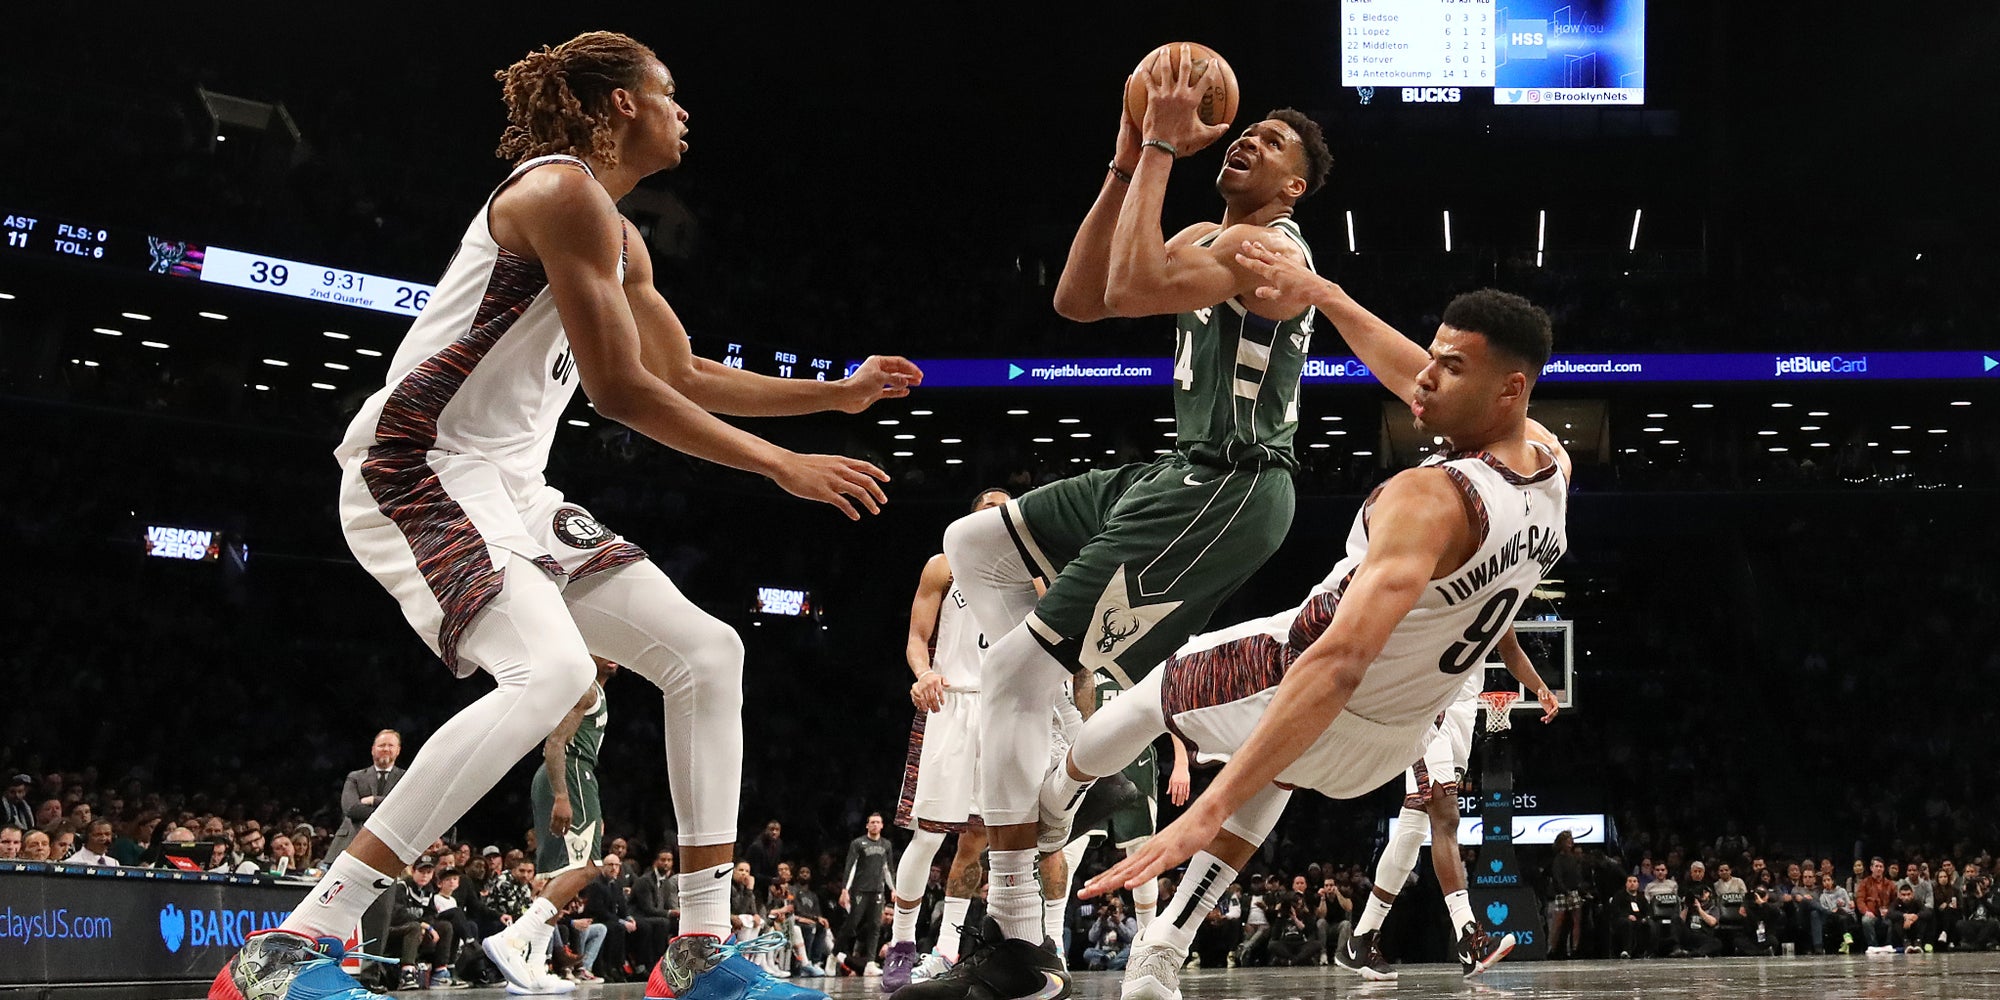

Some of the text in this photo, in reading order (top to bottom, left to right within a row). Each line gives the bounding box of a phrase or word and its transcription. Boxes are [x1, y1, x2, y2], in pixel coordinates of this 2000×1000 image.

[1349, 14, 1487, 22] 6 Bledsoe 0 3 3
[1347, 28, 1487, 37] 11 Lopez 6 1 2
[1556, 25, 1604, 33] HOW YOU
[1347, 42, 1487, 50] 22 Middleton 3 2 1
[1512, 32, 1544, 46] HSS
[1347, 56, 1487, 64] 26 Korver 6 0 1
[1347, 70, 1487, 79] 34 Antetokounmp 14 1 6
[1402, 87, 1461, 103] BUCKS
[1543, 91, 1628, 103] @BrooklynNets
[3, 214, 38, 230] AST
[8, 231, 28, 248] 11
[58, 224, 108, 242] FLS: 0
[54, 239, 104, 258] TOL: 6
[250, 260, 289, 286] 39
[322, 270, 365, 292] 9:31
[310, 288, 375, 307] 2nd Quarter
[394, 286, 430, 311] 26
[728, 343, 742, 354] FT
[722, 356, 743, 370] 4/4
[774, 351, 797, 364] REB
[810, 358, 832, 370] AST
[1173, 330, 1194, 391] 4
[778, 365, 792, 378] 11
[1031, 364, 1152, 380] myjetbluecard.com
[1542, 360, 1642, 376] jetbluecard.com
[816, 371, 825, 382] 6
[147, 525, 212, 547] VISION
[151, 541, 206, 560] ZERO
[758, 587, 804, 605] VISION
[762, 600, 801, 616] ZERO
[1438, 587, 1519, 675] 9
[1476, 874, 1518, 884] BARCLAYS
[1656, 894, 1677, 902] QATAR
